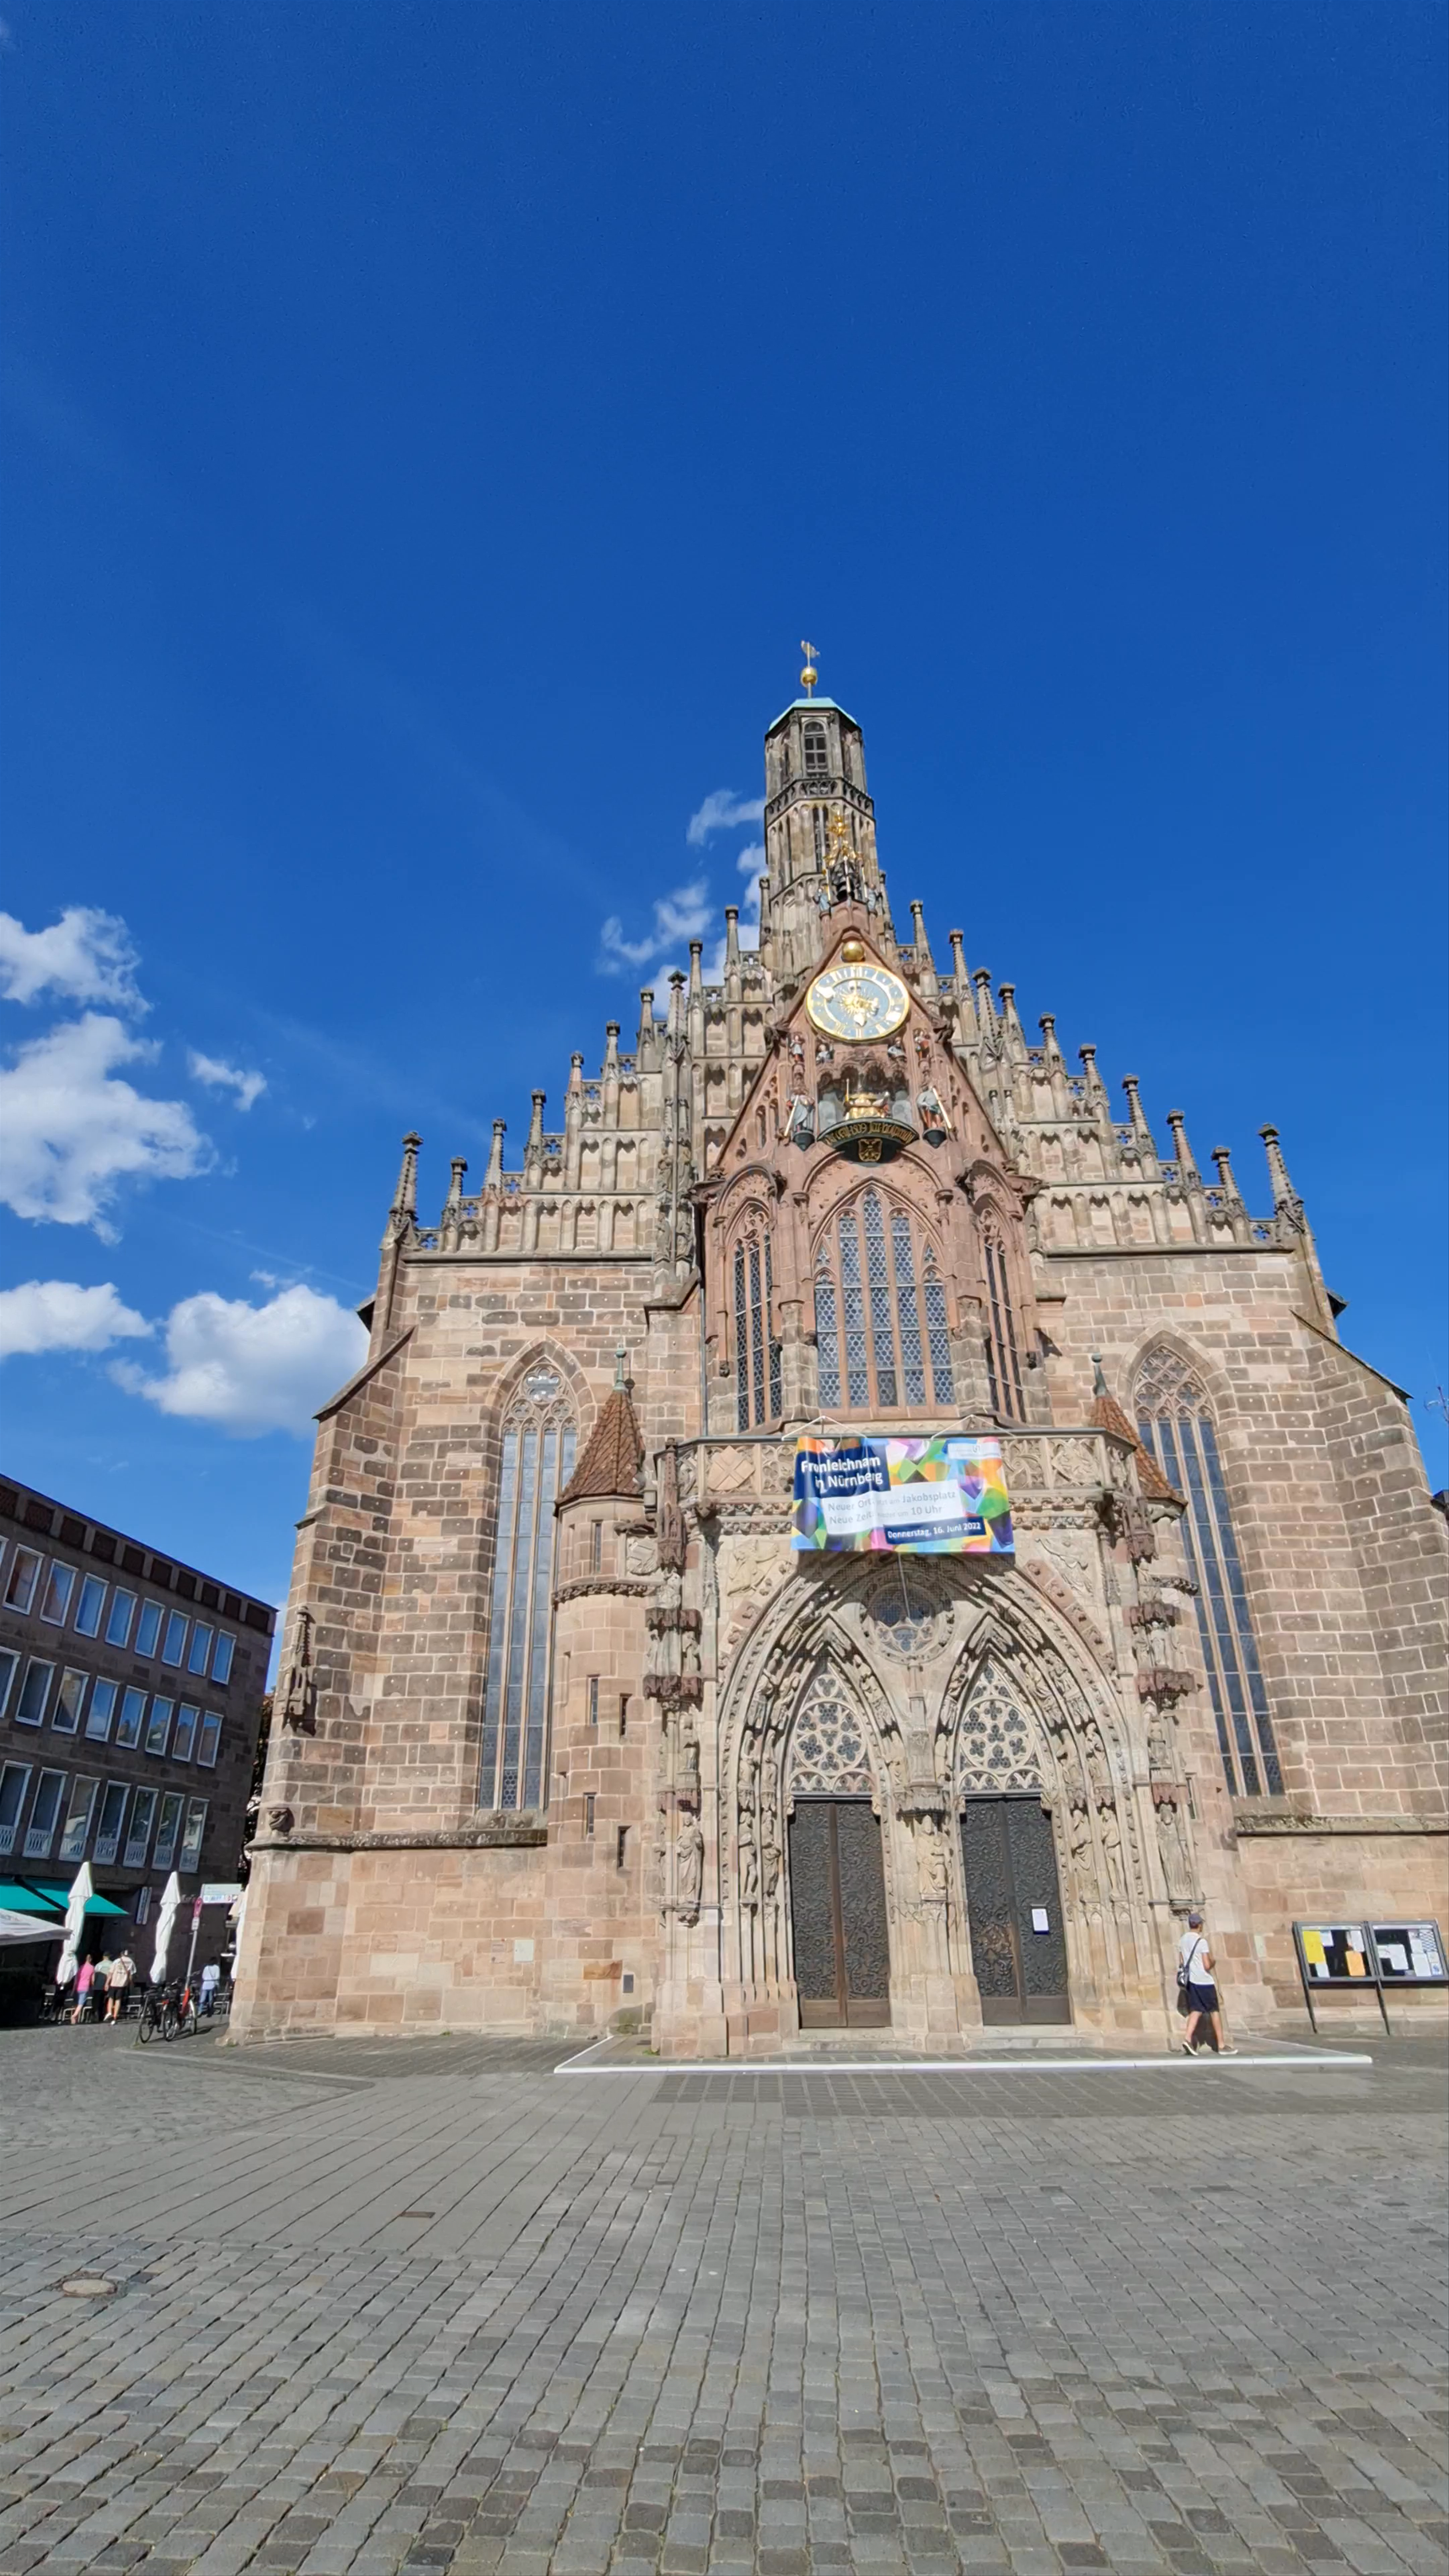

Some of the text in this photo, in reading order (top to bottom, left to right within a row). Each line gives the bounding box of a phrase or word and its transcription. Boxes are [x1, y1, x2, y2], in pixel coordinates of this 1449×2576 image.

[801, 1456, 881, 1473] Fronleichnam
[815, 1472, 883, 1494] in Nürnberg
[828, 1503, 854, 1512] Neuer
[902, 1492, 956, 1503] Jakobsplatz
[830, 1516, 853, 1524] Neue
[911, 1506, 923, 1515] 10
[925, 1505, 943, 1514] Uhr
[947, 1524, 962, 1533] Juni
[963, 1522, 981, 1530] 2022
